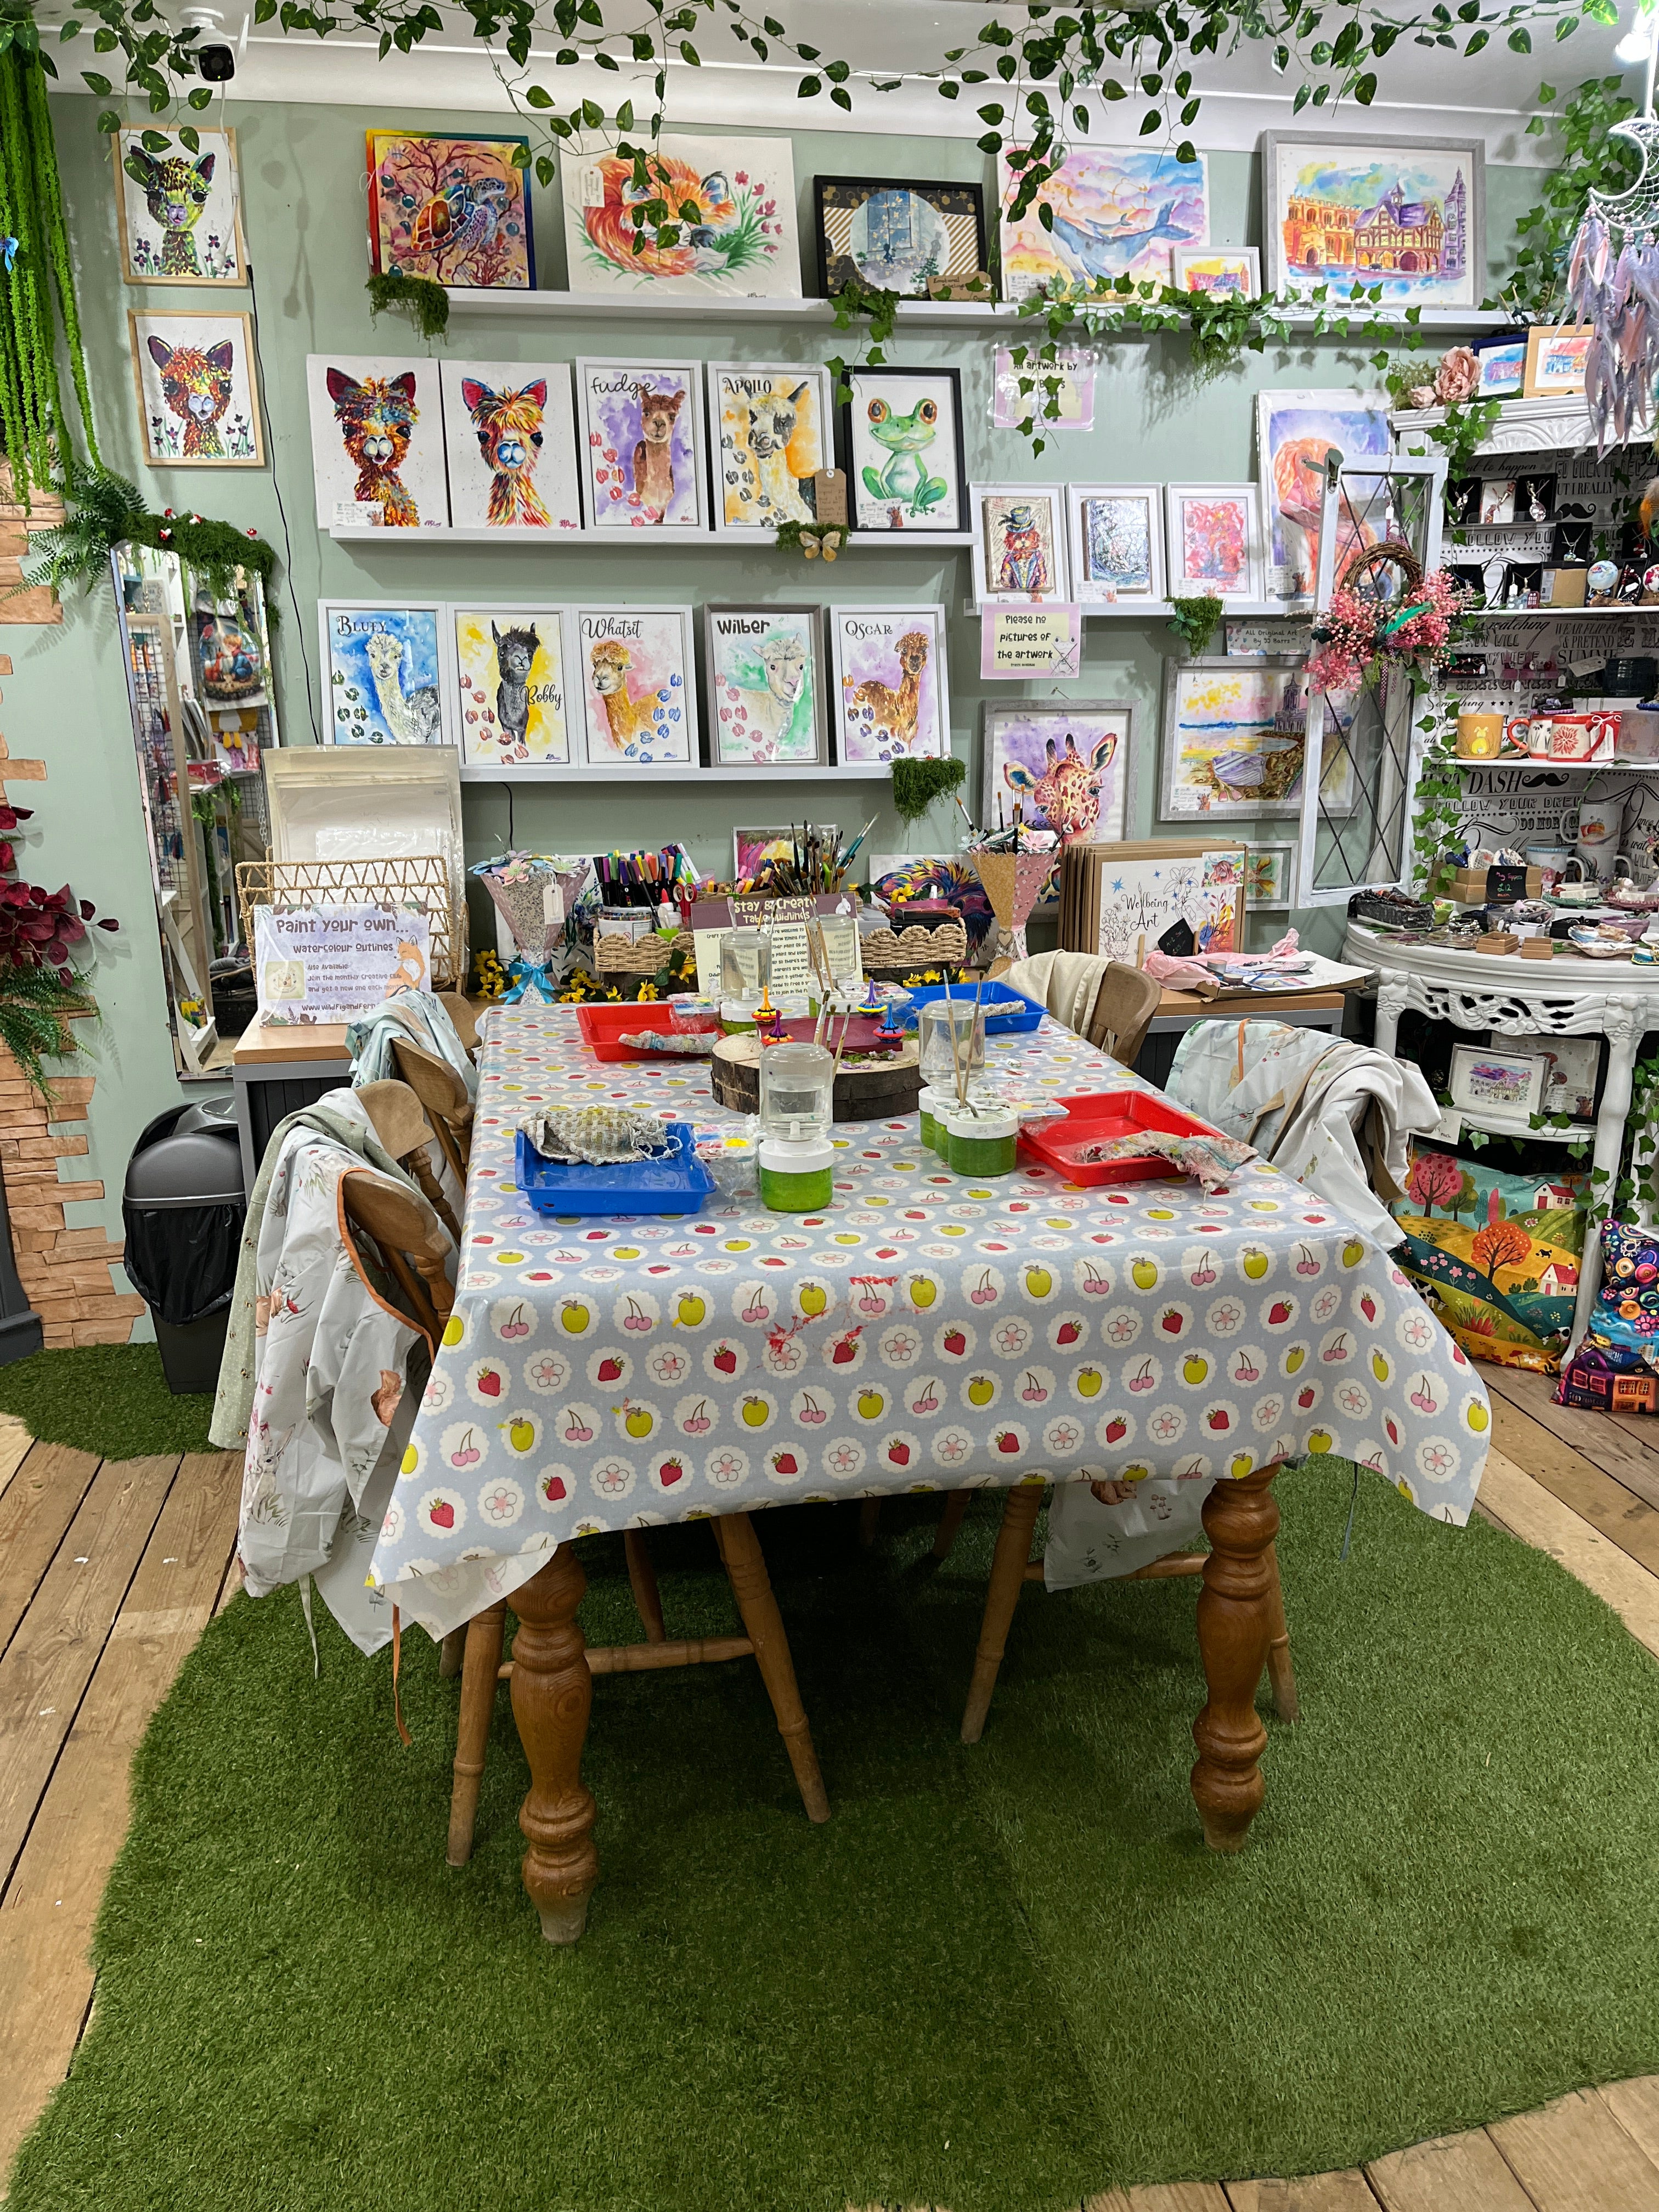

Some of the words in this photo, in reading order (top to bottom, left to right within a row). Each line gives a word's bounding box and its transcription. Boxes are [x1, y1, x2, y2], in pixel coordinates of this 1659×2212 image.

[1026, 361, 1064, 370] artwork
[1067, 362, 1077, 371] by
[1557, 483, 1570, 495] UT
[1466, 532, 1516, 546] OLLOW
[1524, 530, 1554, 544] YOU
[1006, 615, 1032, 624] Please
[1036, 615, 1046, 624] no
[582, 617, 644, 639] Whatsit
[717, 619, 770, 635] Wilber
[1000, 633, 1038, 642] pictures
[1258, 630, 1285, 638] Original
[1572, 635, 1615, 648] PRETEND
[997, 650, 1012, 659] the
[1015, 650, 1053, 659] artwork
[520, 684, 562, 710] Bobby
[1468, 770, 1524, 794] DASH
[1499, 798, 1537, 810] YOUR
[1520, 817, 1534, 831] DO
[734, 901, 760, 913] Stay
[1121, 892, 1168, 914] Wellbeing
[742, 915, 770, 924] Tabe
[1130, 913, 1160, 931] Art
[276, 919, 317, 933] Paint
[323, 919, 358, 932] your
[294, 944, 352, 953] Watercolour
[356, 943, 393, 952] Outlines
